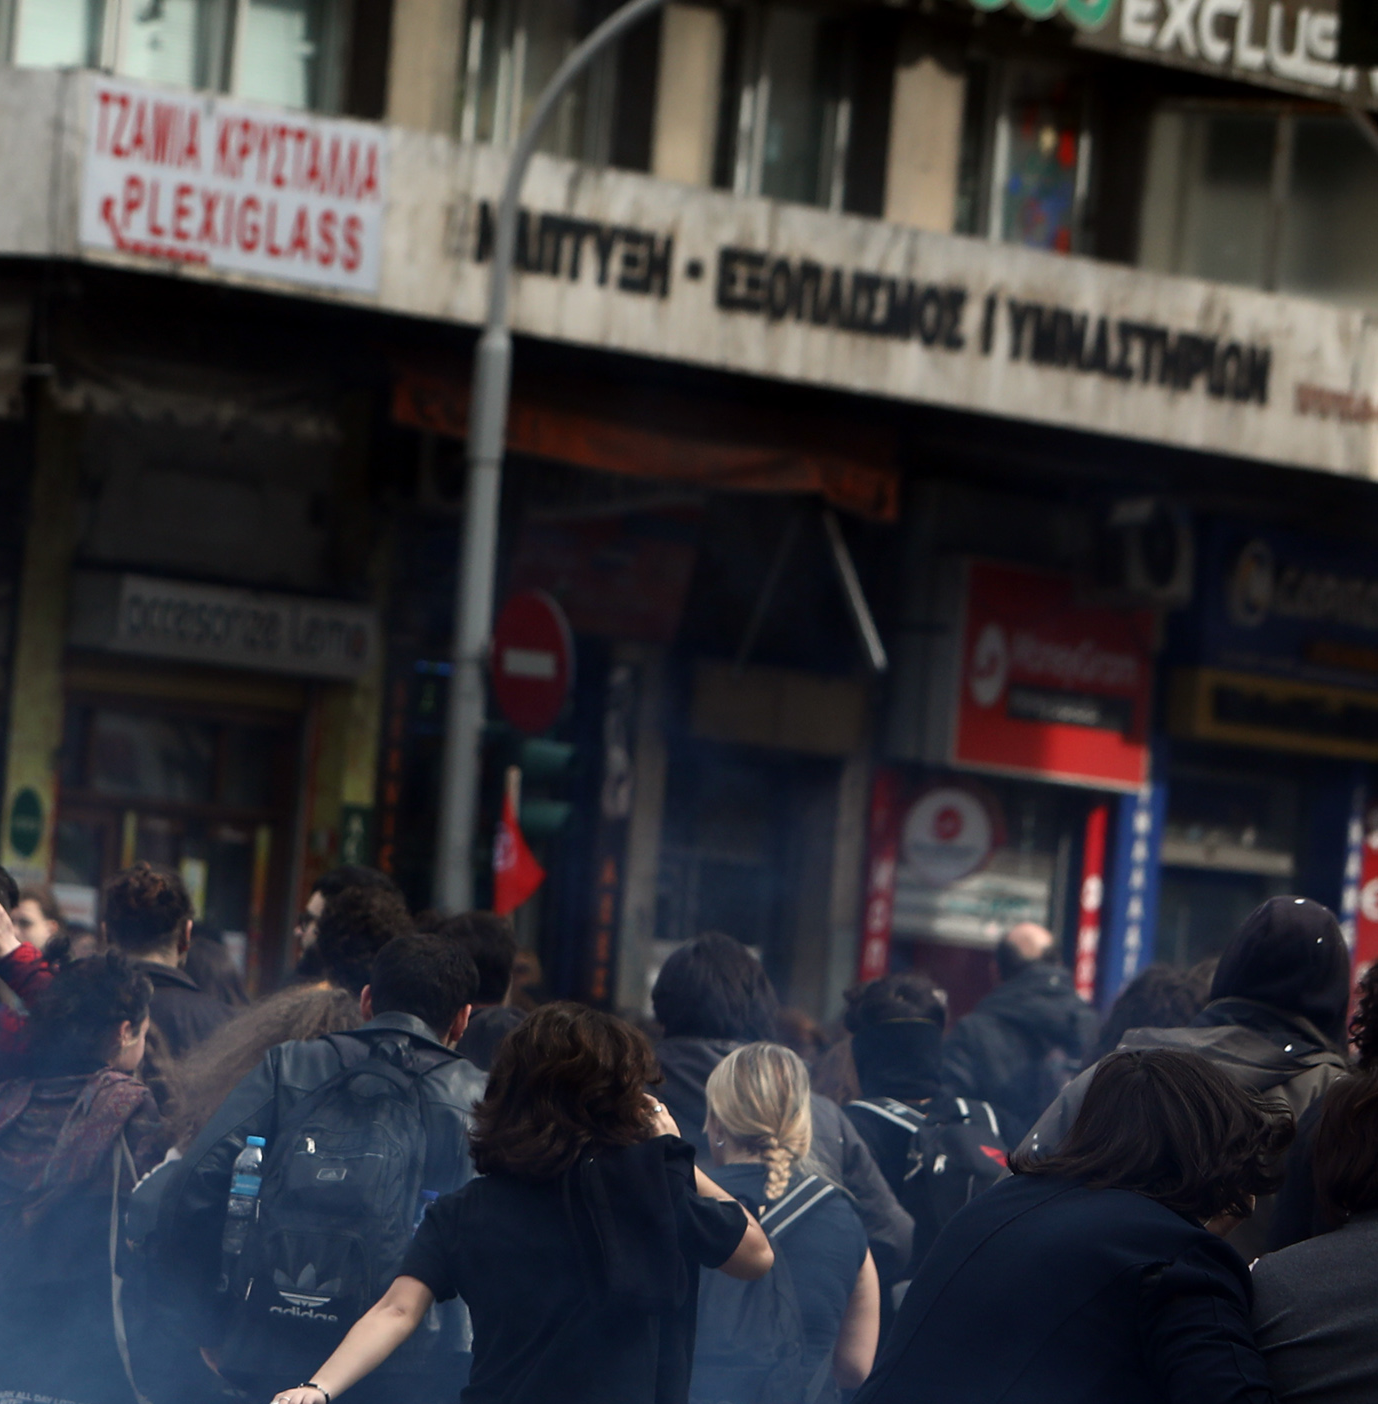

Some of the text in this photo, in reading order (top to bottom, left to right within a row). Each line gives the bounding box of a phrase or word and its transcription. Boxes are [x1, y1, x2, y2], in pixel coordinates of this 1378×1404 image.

[120, 173, 363, 274] PLEXIGLASS
[15, 1391, 32, 1401] ALL
[33, 1393, 53, 1404] DAY
